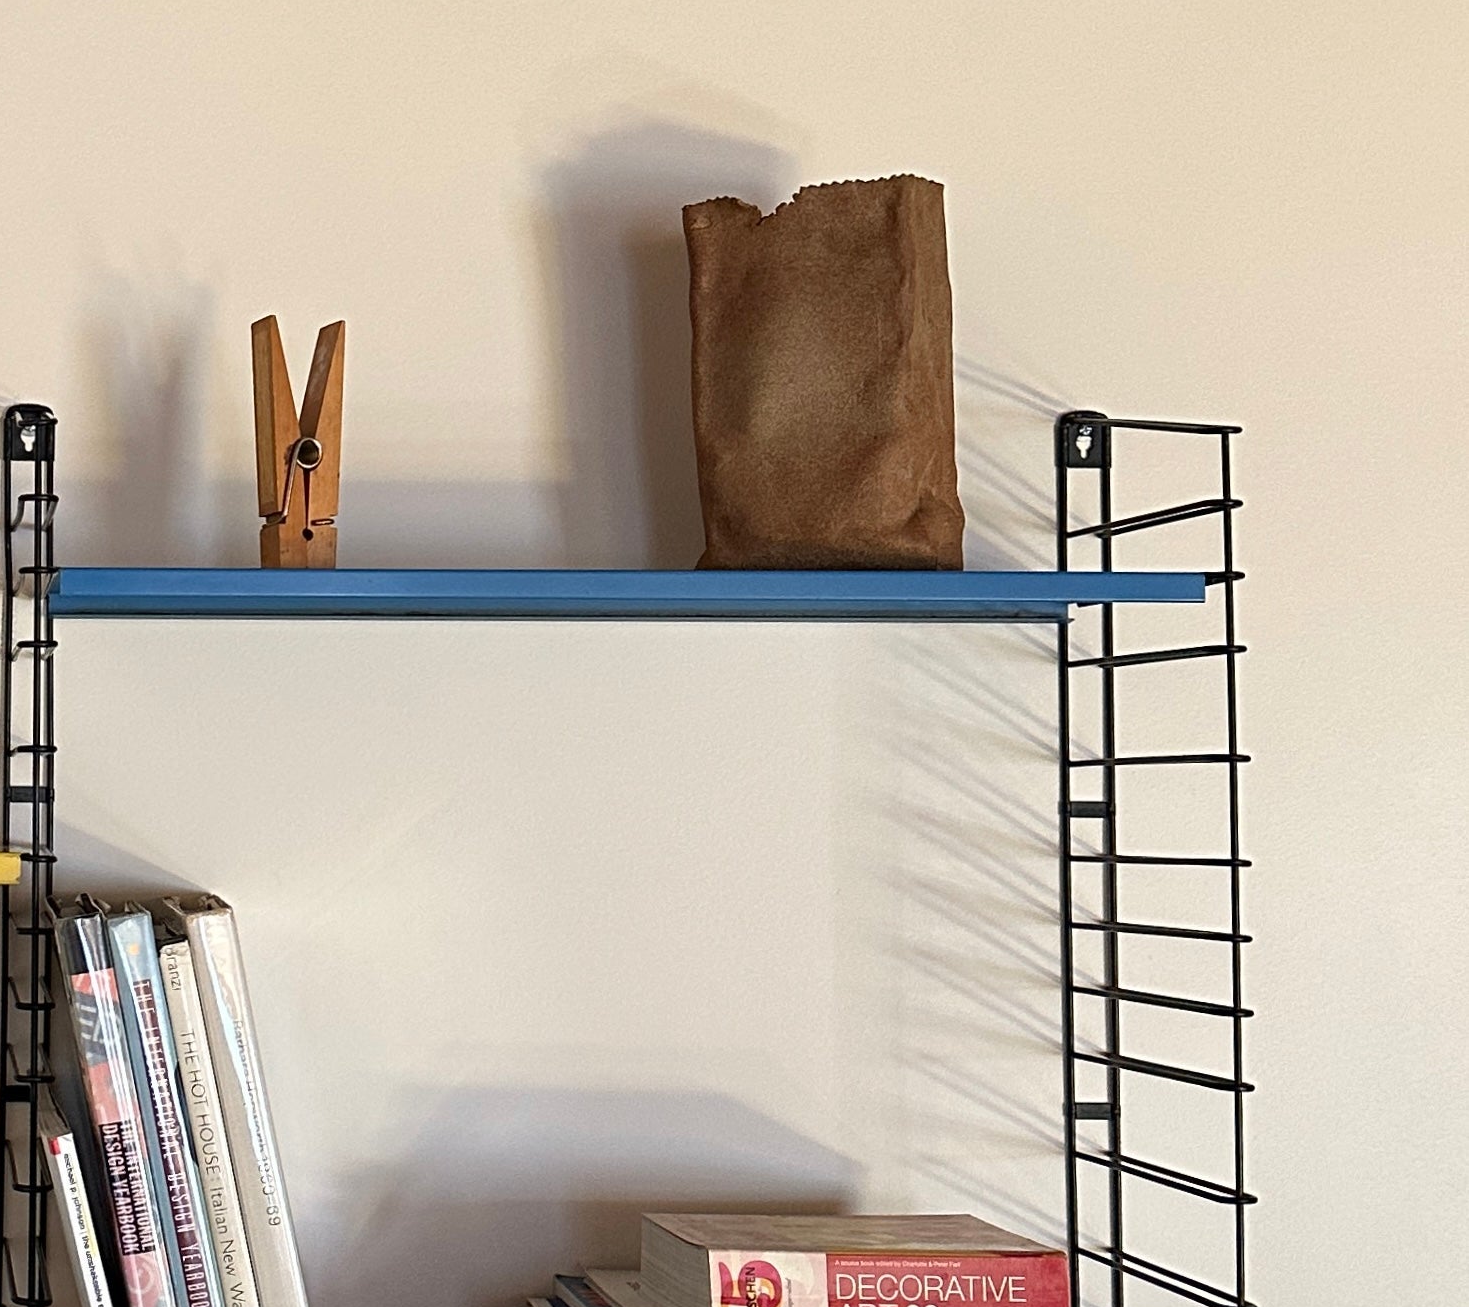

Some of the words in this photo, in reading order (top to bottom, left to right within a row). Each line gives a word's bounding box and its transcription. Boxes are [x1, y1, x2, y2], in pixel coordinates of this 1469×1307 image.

[180, 1029, 197, 1065] THE
[133, 981, 156, 1013] THE
[167, 1173, 196, 1233] DESIGN
[188, 1069, 209, 1107] HOT
[102, 1124, 124, 1176] DESIGN
[113, 1178, 139, 1254] YEARBOOK
[124, 1151, 156, 1252] INTERNATIONAL
[209, 1186, 229, 1235] Italian
[71, 1196, 86, 1230] johnson
[82, 1235, 91, 1250] the
[220, 1240, 238, 1277] New
[835, 1273, 1027, 1303] DECORATIVE
